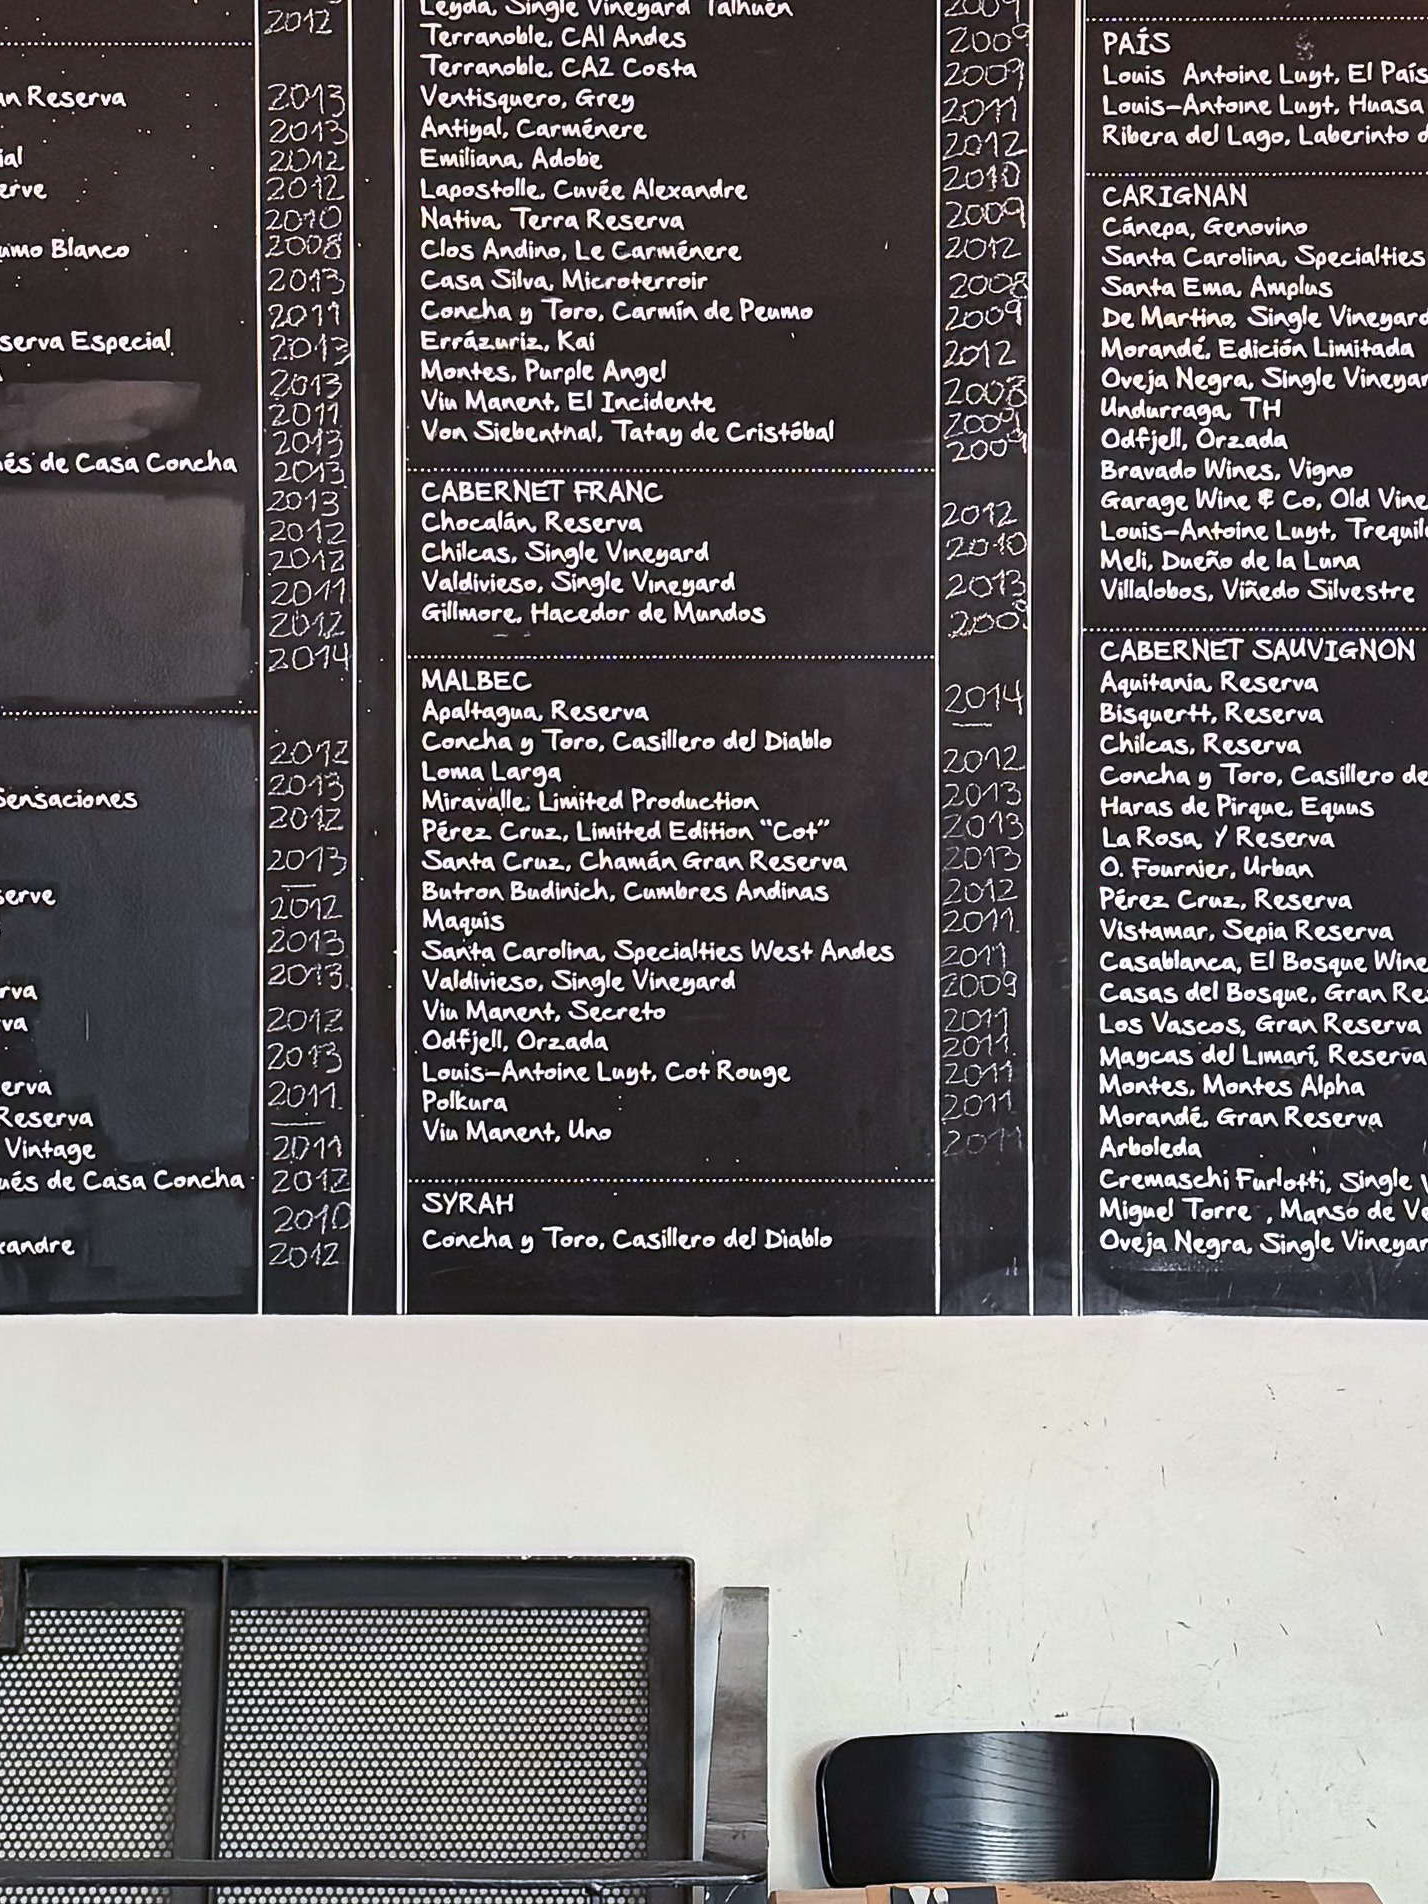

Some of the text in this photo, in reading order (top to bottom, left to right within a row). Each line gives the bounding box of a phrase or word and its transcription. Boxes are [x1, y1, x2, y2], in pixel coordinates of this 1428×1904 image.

[1102, 26, 1171, 56] PAÍS
[420, 114, 509, 143] Antiyal,
[1102, 182, 1248, 208] CARIGNAN
[1102, 215, 1308, 241] Cánepa, Genovino
[420, 328, 595, 353] Errázuriz, Kai
[1100, 456, 1354, 487] Bravado Wines, Vigno
[421, 478, 664, 504] CABERNET FRANC
[1100, 547, 1361, 572] Meli, Dueño de la Luna
[1099, 636, 1416, 663] CABERNET SAUVIGNON
[421, 668, 533, 693] MALBEC
[1131, 856, 1236, 880] Fournier,
[1243, 854, 1315, 880] Urban
[421, 877, 830, 903] Butron Budinich, Cumbres Andinas
[1098, 1104, 1384, 1133] Morandé, Gran Reserva
[421, 1190, 514, 1216] SYRAH
